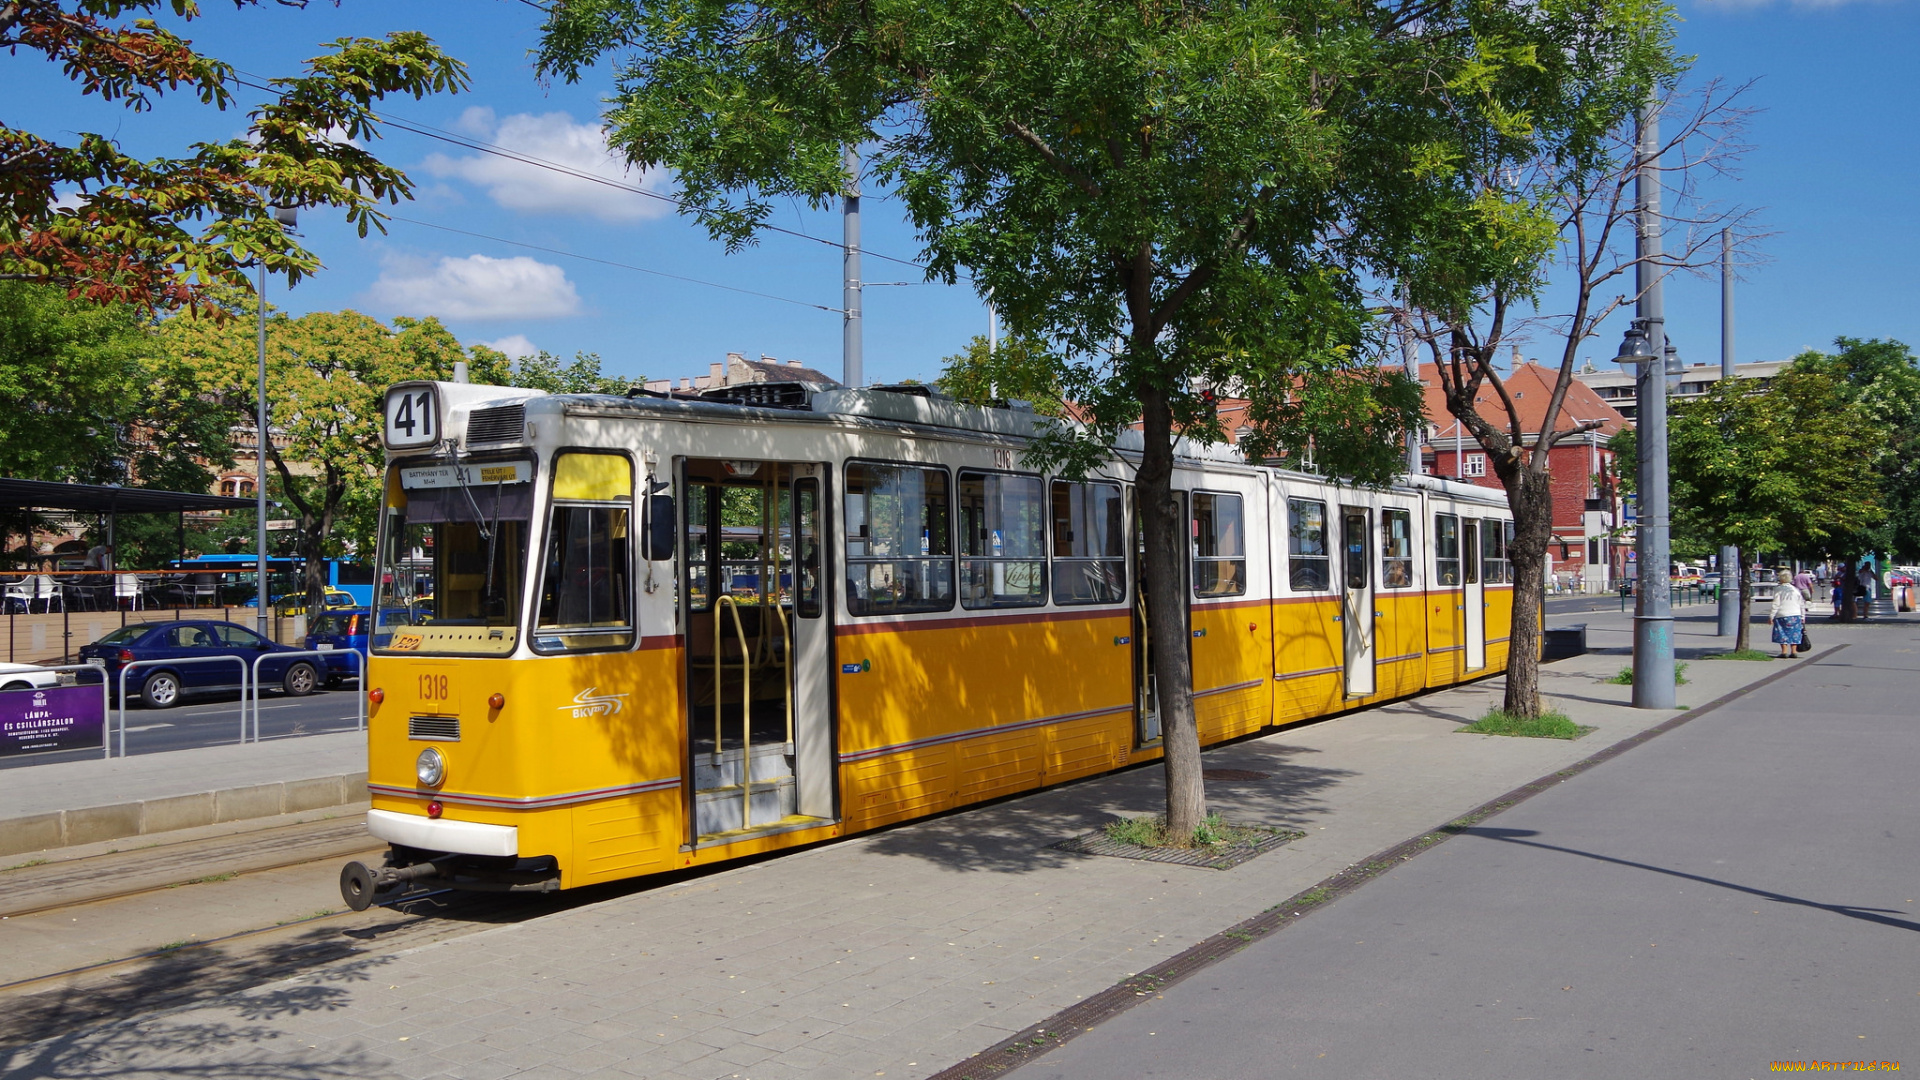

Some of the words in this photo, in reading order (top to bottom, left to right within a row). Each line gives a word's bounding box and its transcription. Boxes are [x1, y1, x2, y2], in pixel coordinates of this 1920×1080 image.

[394, 391, 431, 437] 41
[994, 448, 1011, 469] 1318
[418, 674, 448, 700] 1318
[572, 708, 593, 718] BKV
[4, 722, 13, 730] ÉS
